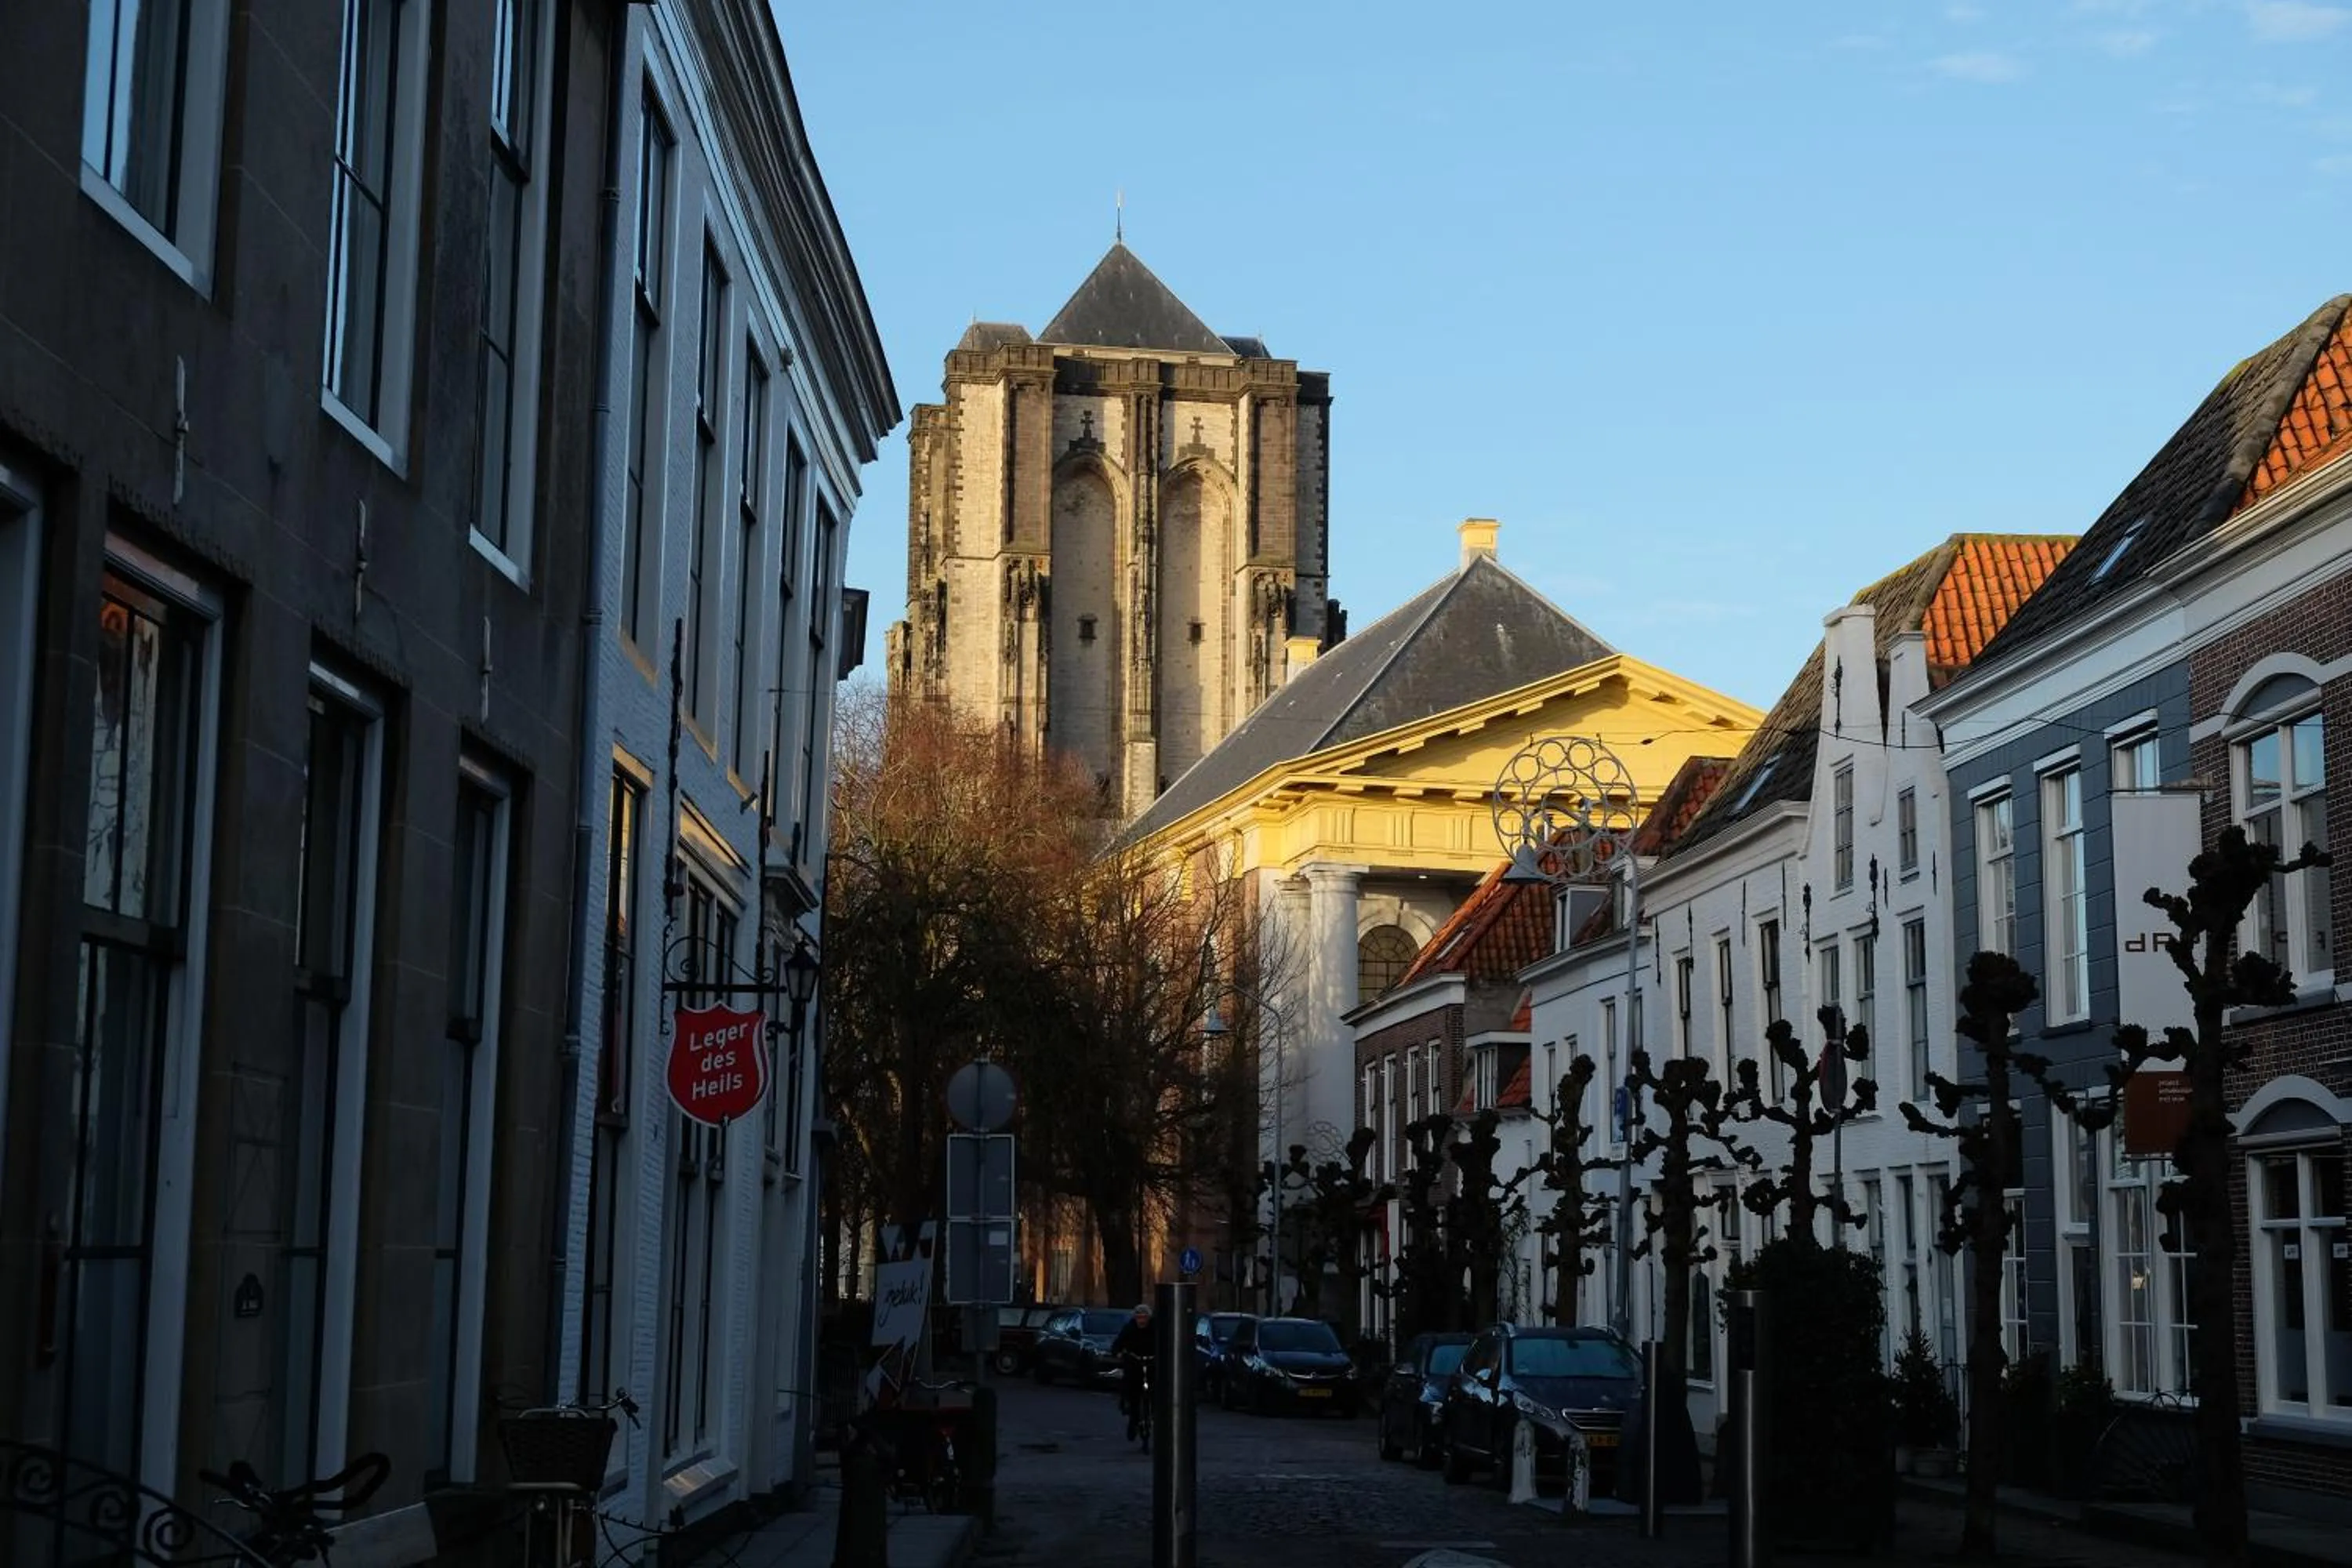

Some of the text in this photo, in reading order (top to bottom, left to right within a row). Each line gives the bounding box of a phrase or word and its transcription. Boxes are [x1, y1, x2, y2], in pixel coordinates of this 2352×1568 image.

[690, 1022, 749, 1051] Leger
[701, 1051, 736, 1073] des
[691, 1072, 743, 1101] Heils
